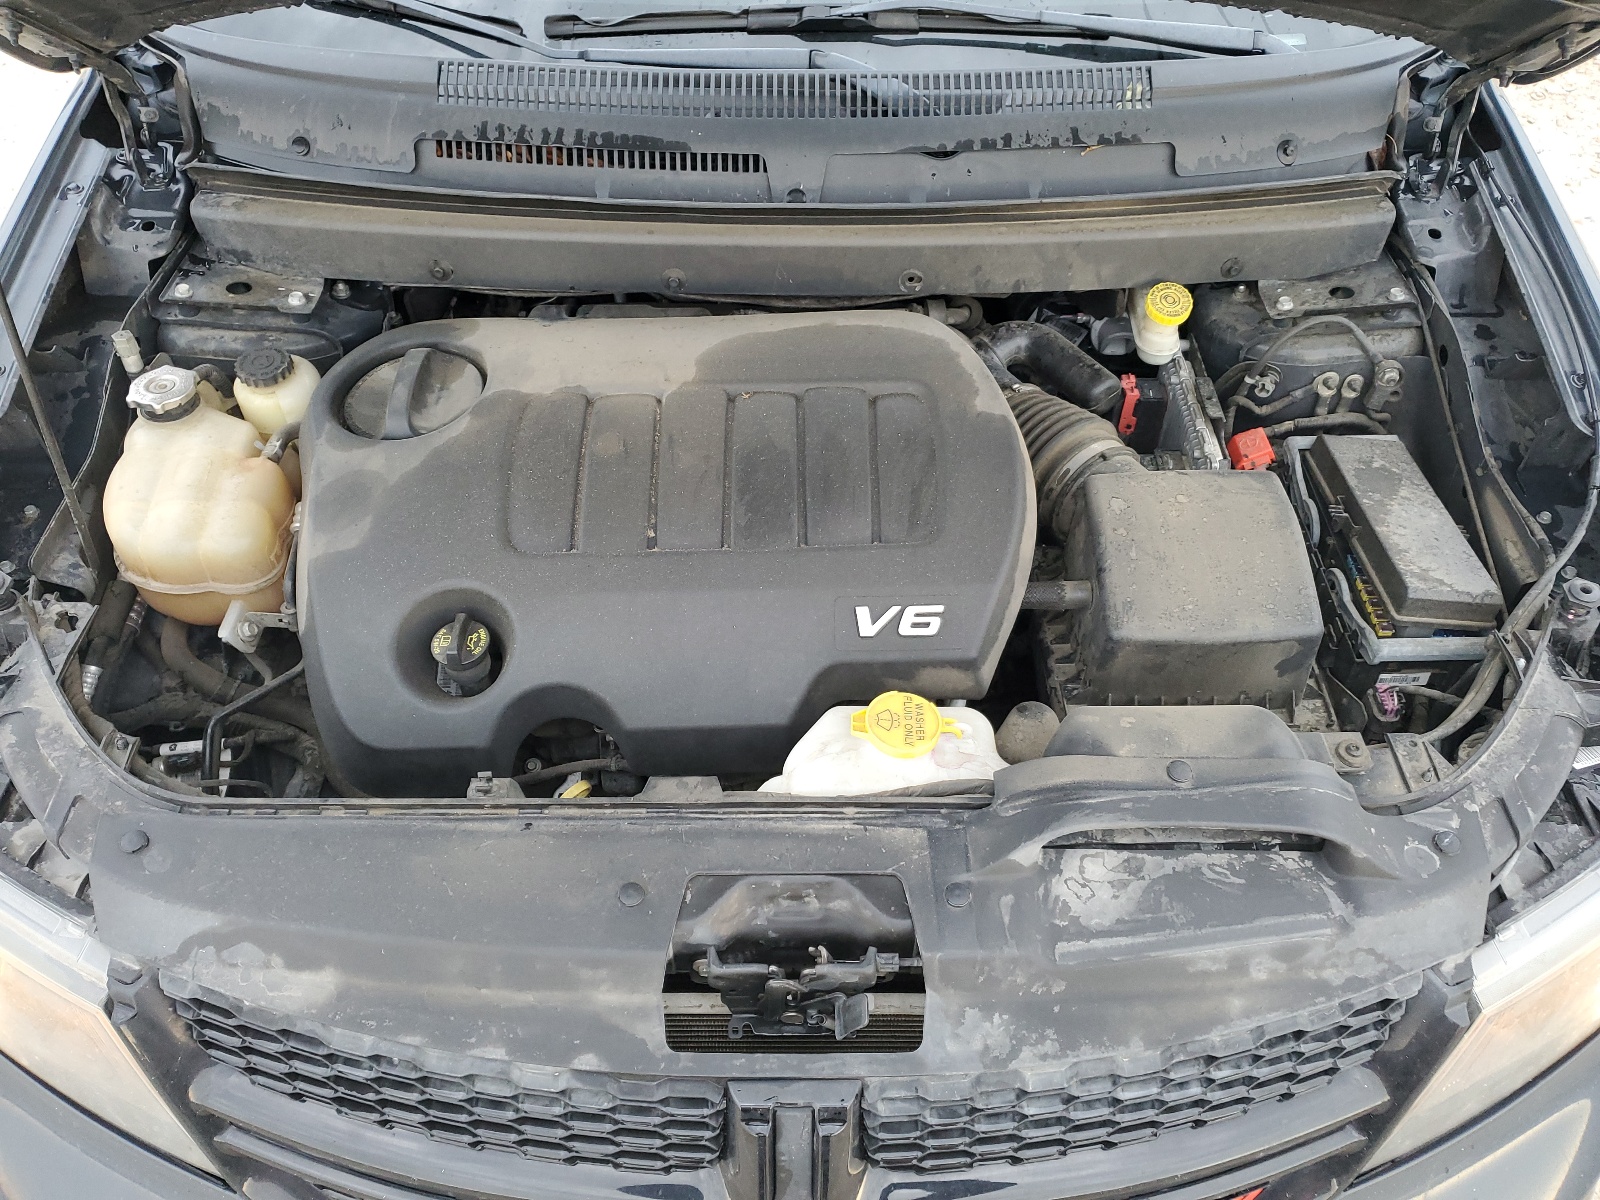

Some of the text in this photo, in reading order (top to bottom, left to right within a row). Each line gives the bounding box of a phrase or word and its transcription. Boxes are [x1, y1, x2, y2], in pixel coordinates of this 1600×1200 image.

[854, 604, 945, 638] V6
[472, 646, 482, 655] OIL
[903, 695, 915, 747] FLUID ONLY
[914, 702, 925, 741] WASHER
